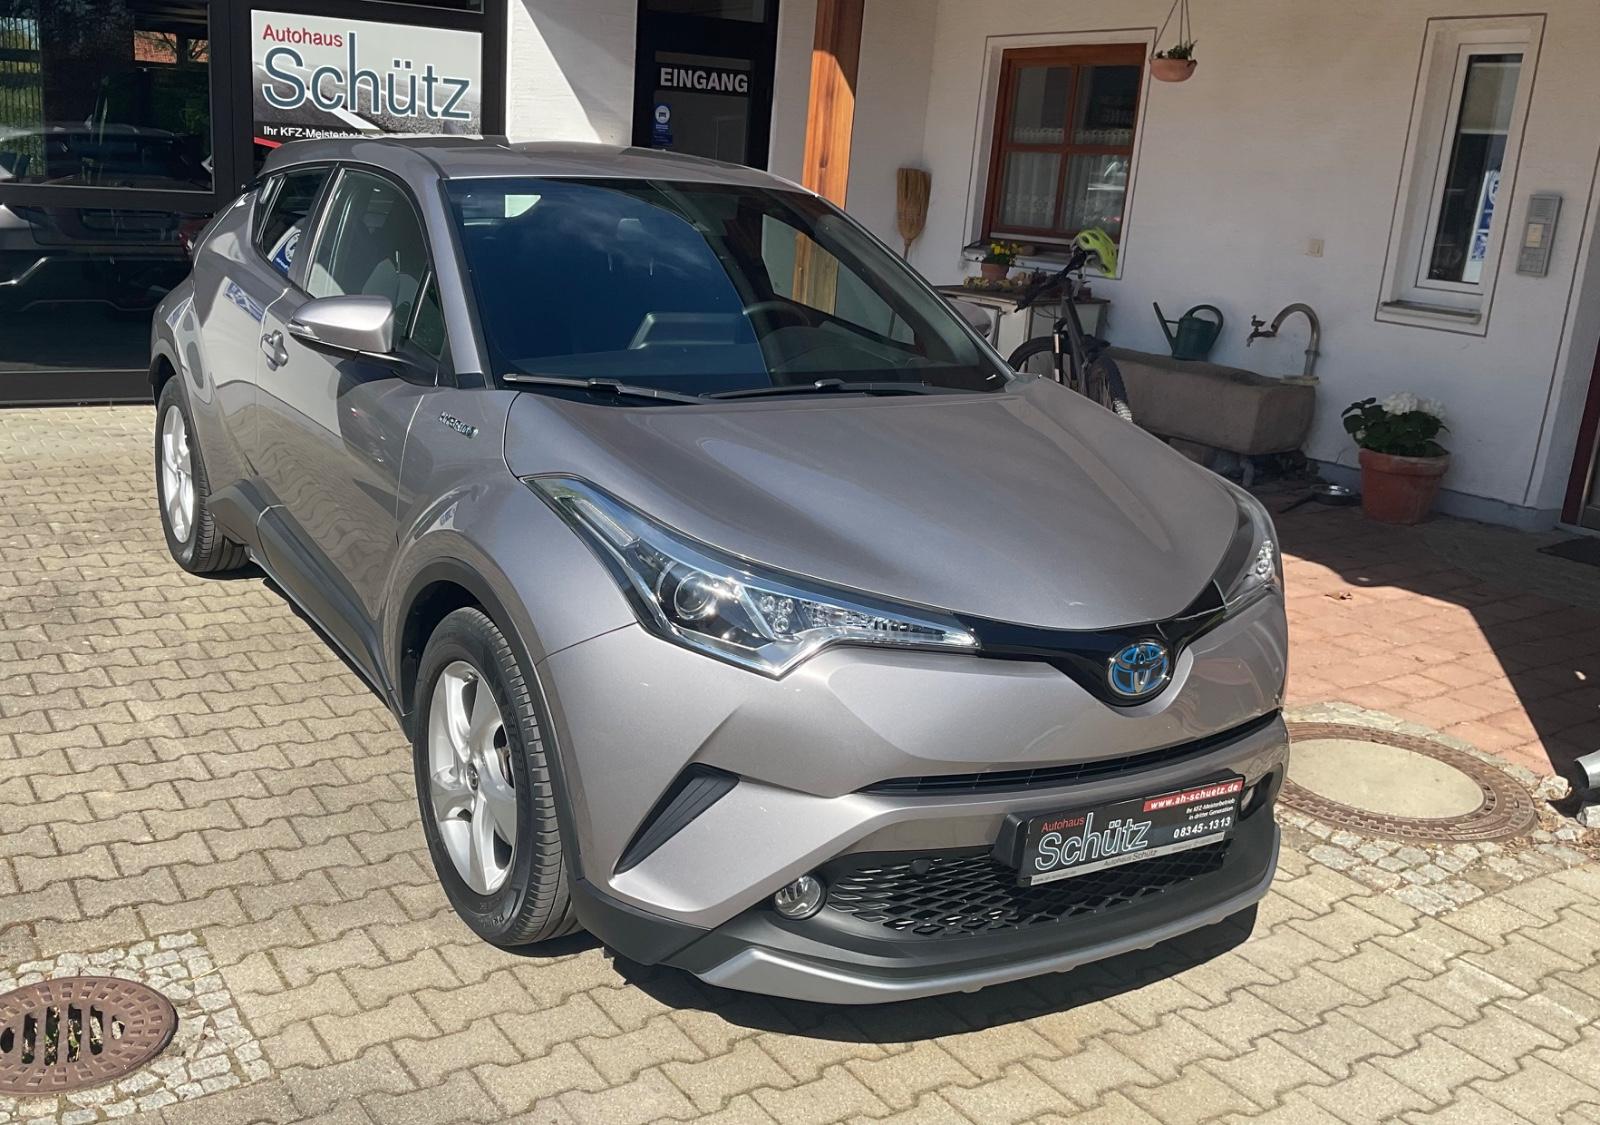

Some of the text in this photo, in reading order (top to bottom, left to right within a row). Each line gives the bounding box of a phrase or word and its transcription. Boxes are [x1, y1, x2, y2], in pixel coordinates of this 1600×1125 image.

[262, 24, 343, 48] Autohaus
[261, 31, 472, 121] Schütz
[659, 67, 748, 93] EINGANG
[263, 125, 278, 136] Ihr
[1150, 783, 1239, 810] www.ah-schuetz.de
[1041, 817, 1085, 833] Autohaus
[1173, 816, 1232, 839] 08345-1313
[1034, 812, 1152, 871] Schütz
